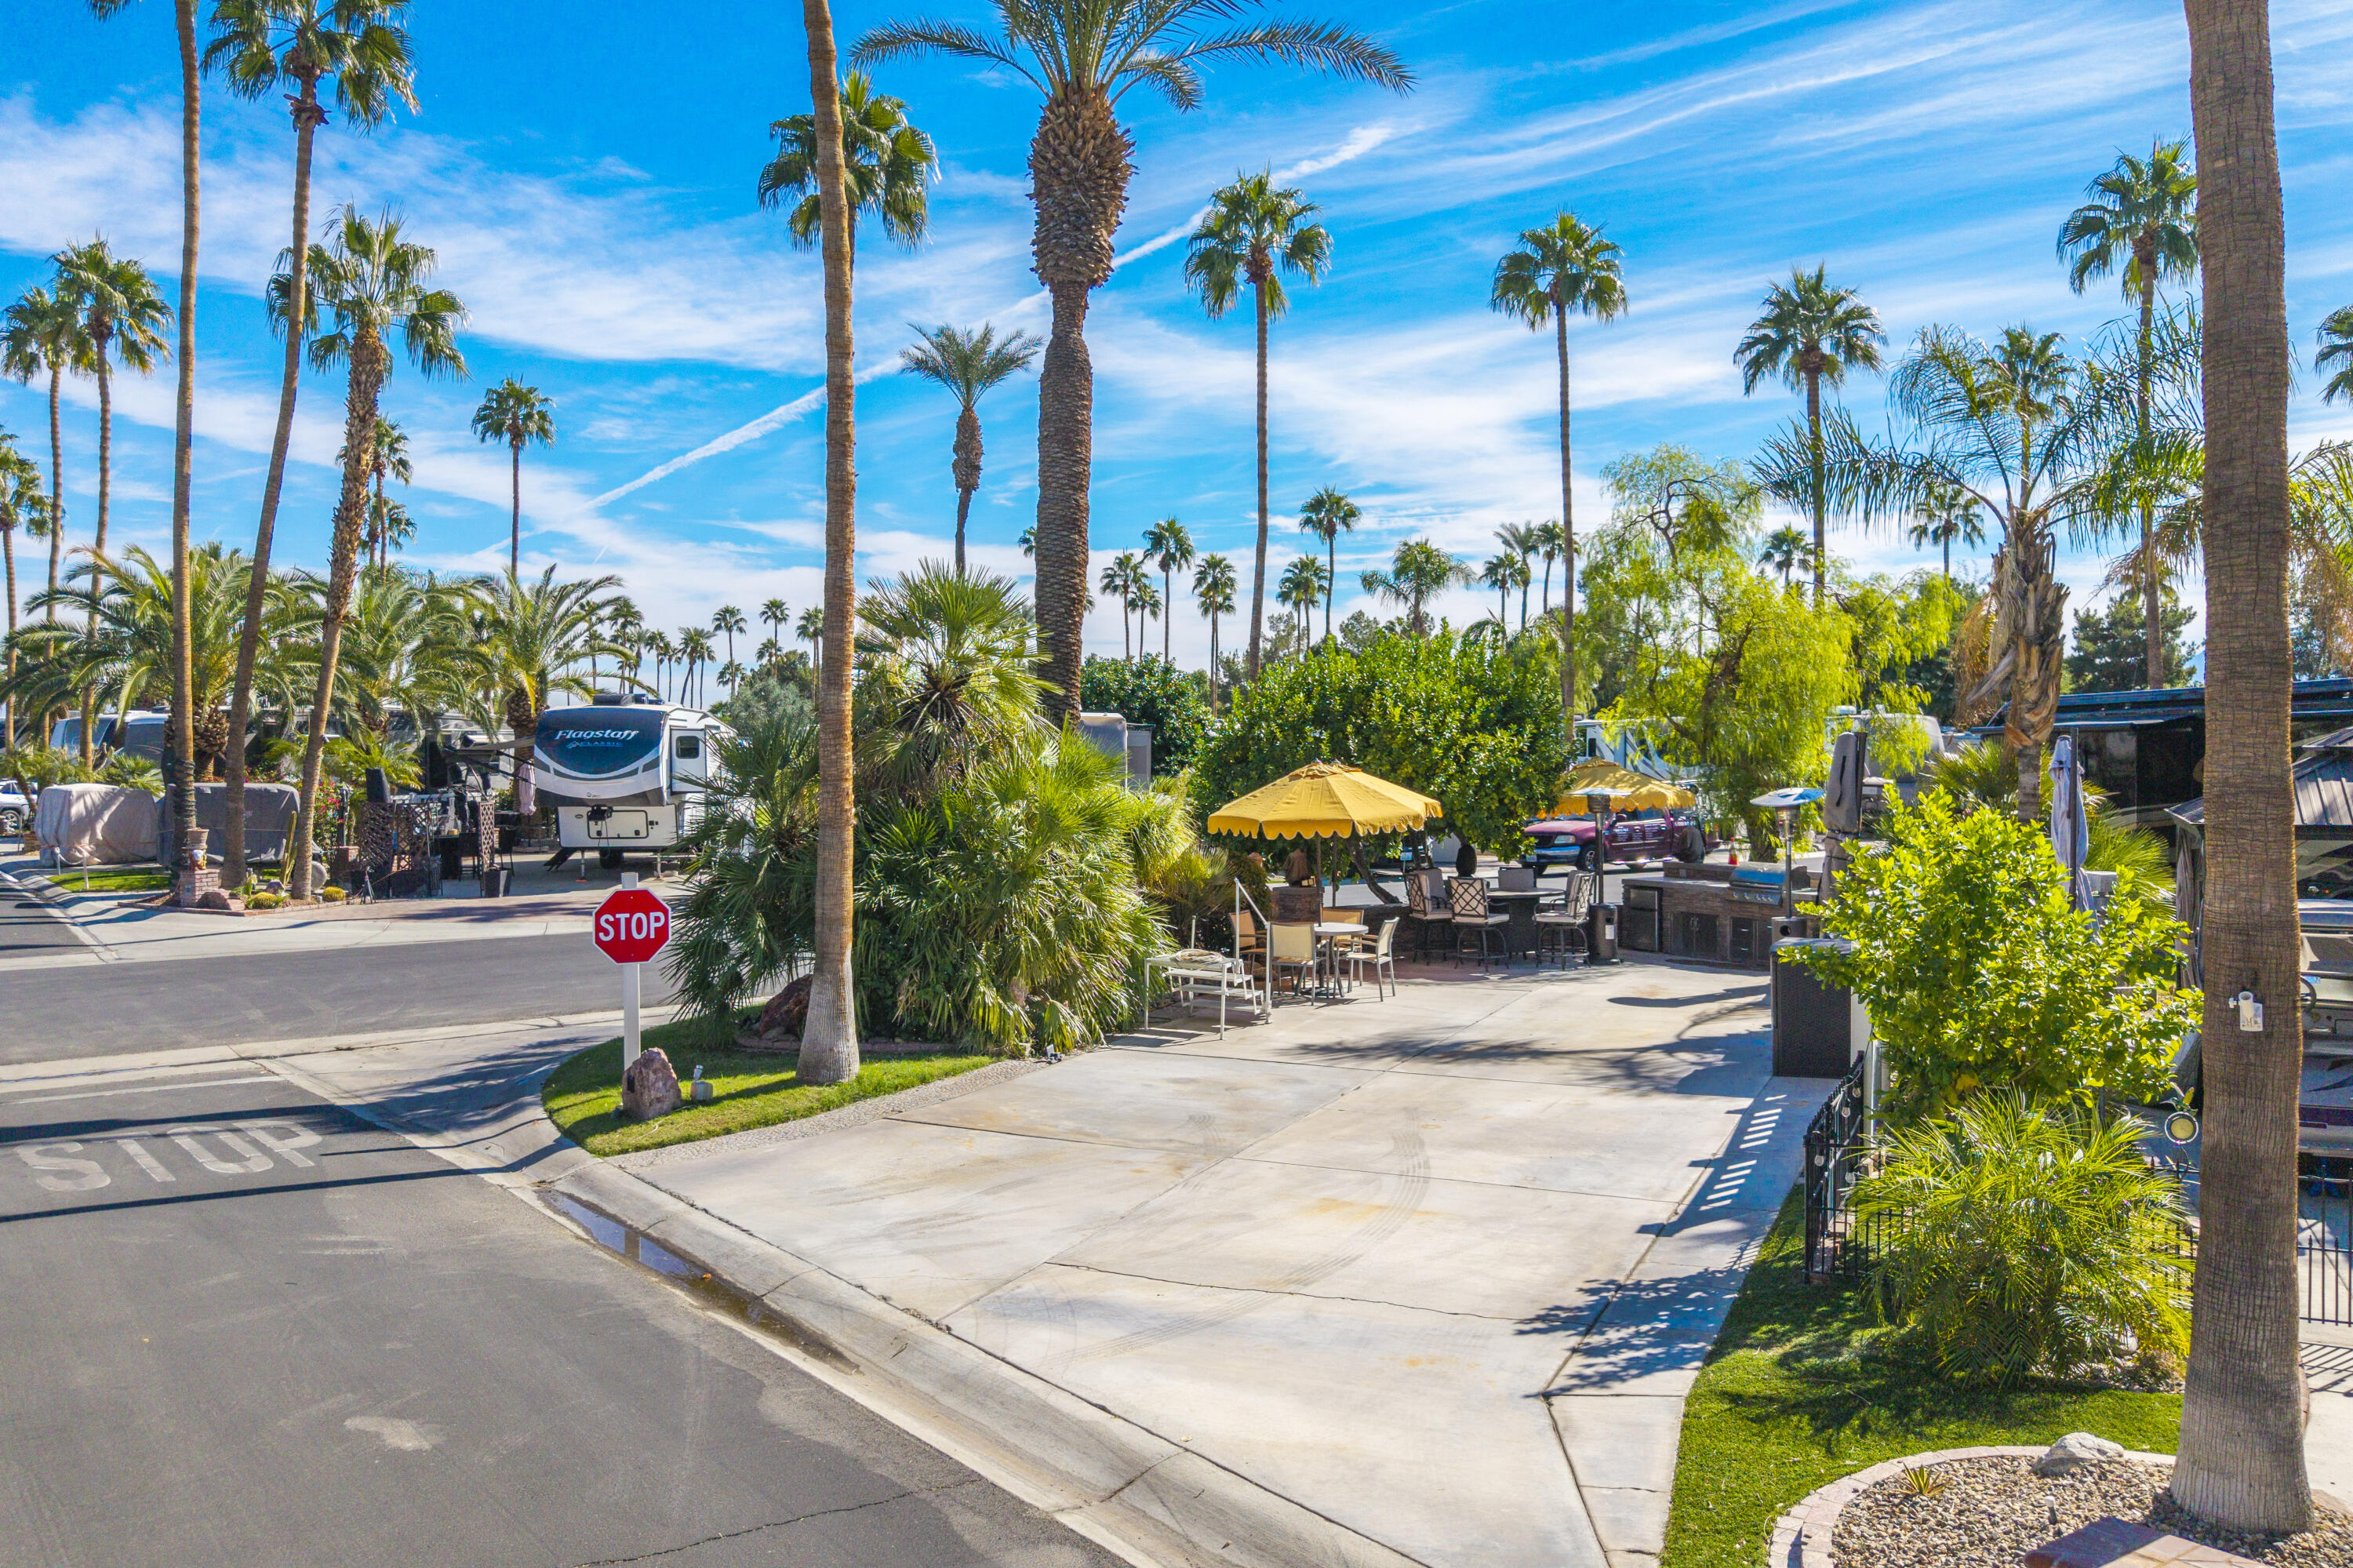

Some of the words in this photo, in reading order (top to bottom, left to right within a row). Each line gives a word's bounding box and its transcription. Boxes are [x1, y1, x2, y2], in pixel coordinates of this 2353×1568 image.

[555, 729, 639, 740] Flagstaff
[598, 911, 665, 941] STOP
[14, 1120, 322, 1191] STOP
